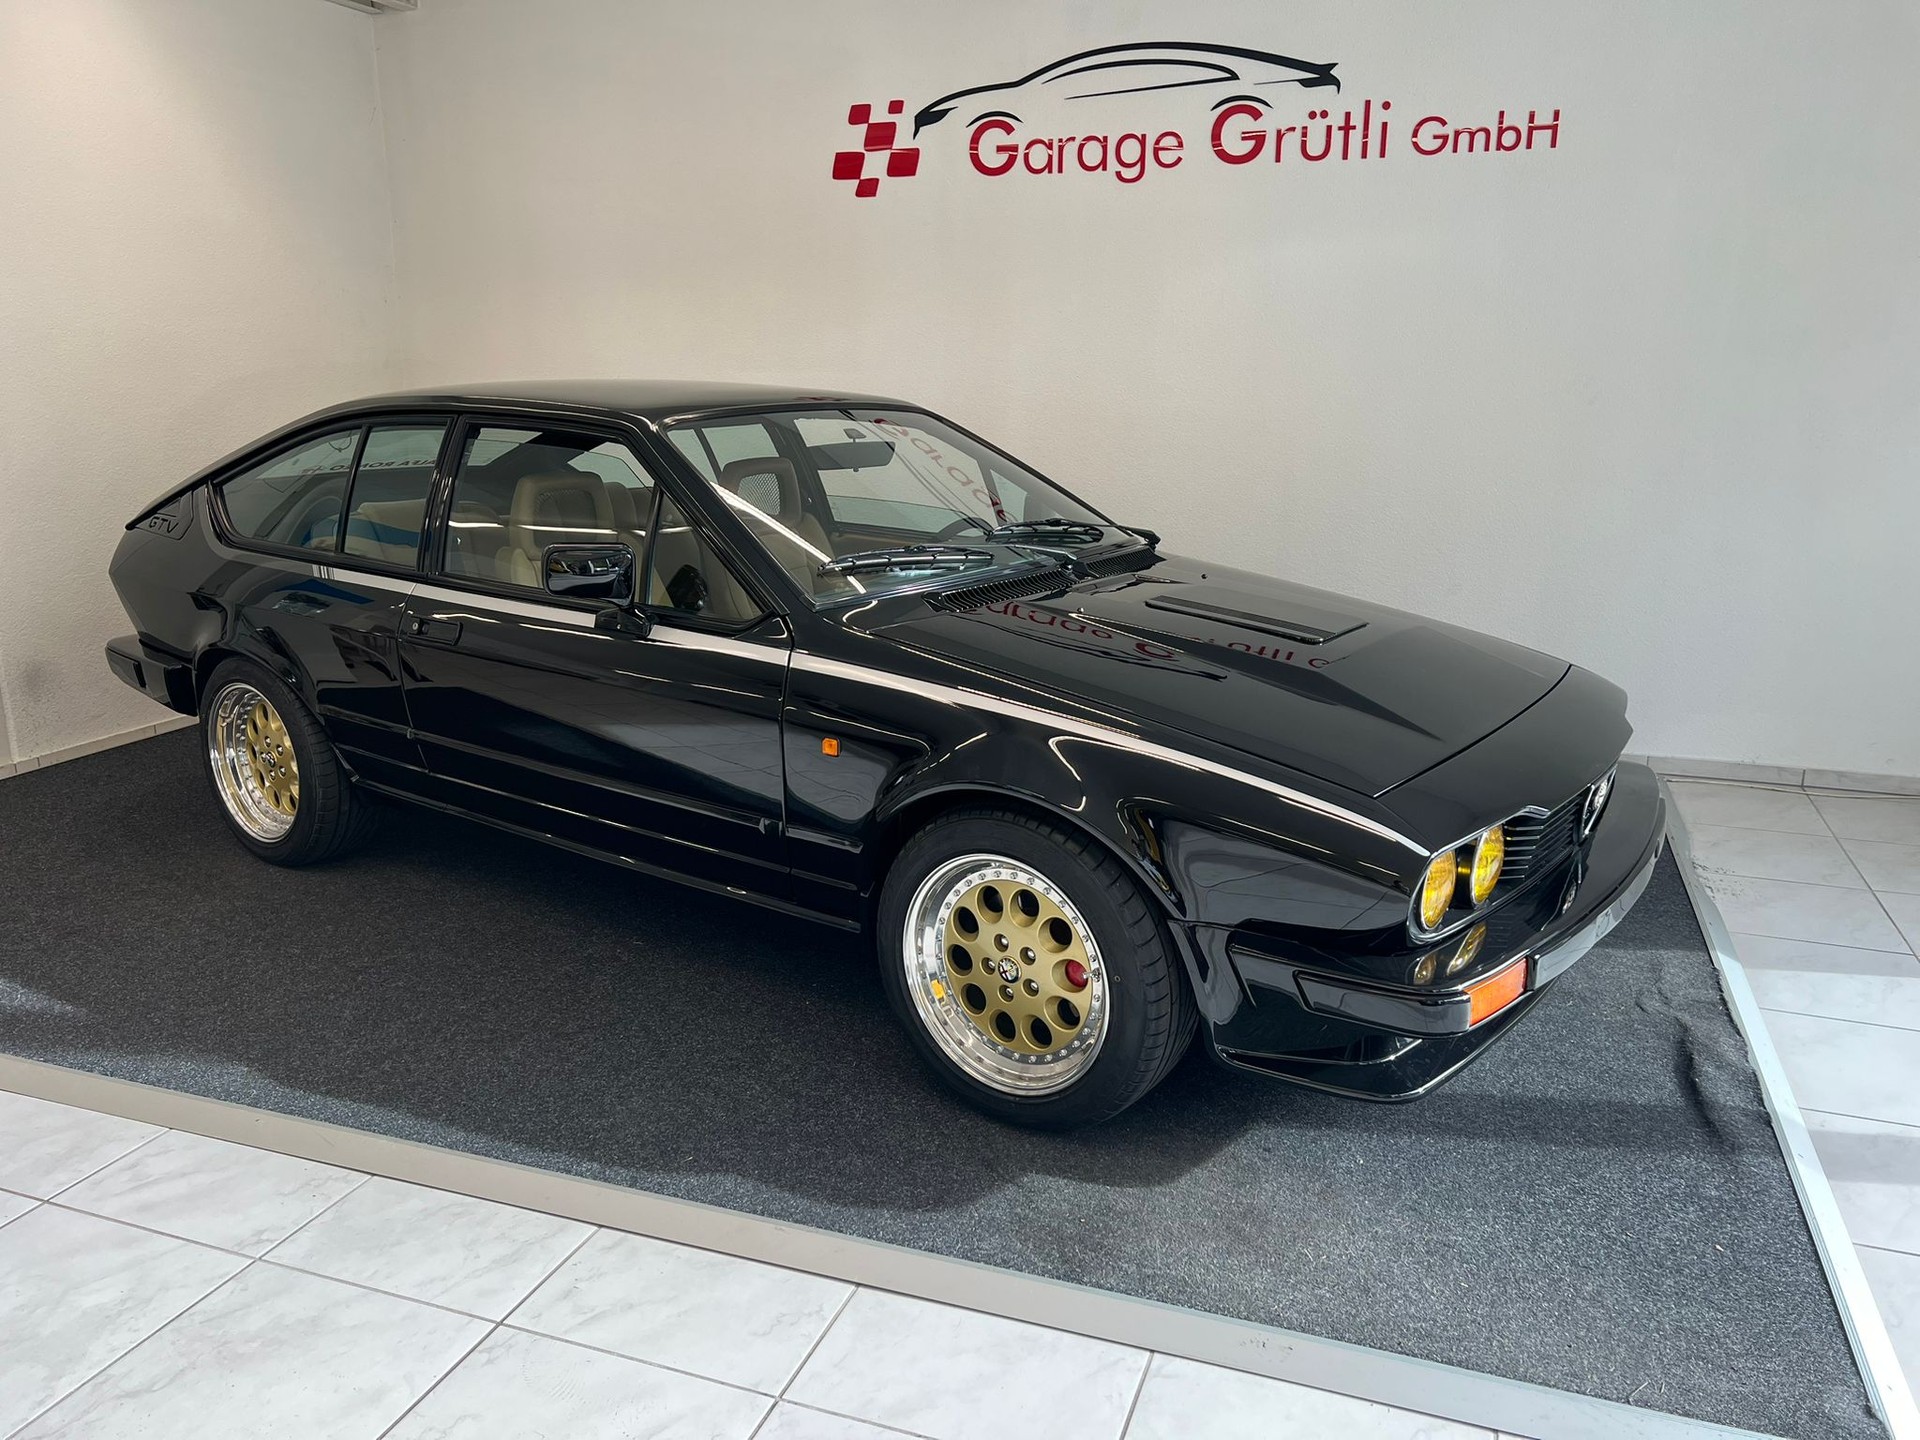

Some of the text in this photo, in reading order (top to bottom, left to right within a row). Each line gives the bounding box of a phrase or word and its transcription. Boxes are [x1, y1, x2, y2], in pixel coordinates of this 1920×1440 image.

[968, 100, 1561, 184] Garage Grütli GmbH
[149, 516, 179, 533] GTV
